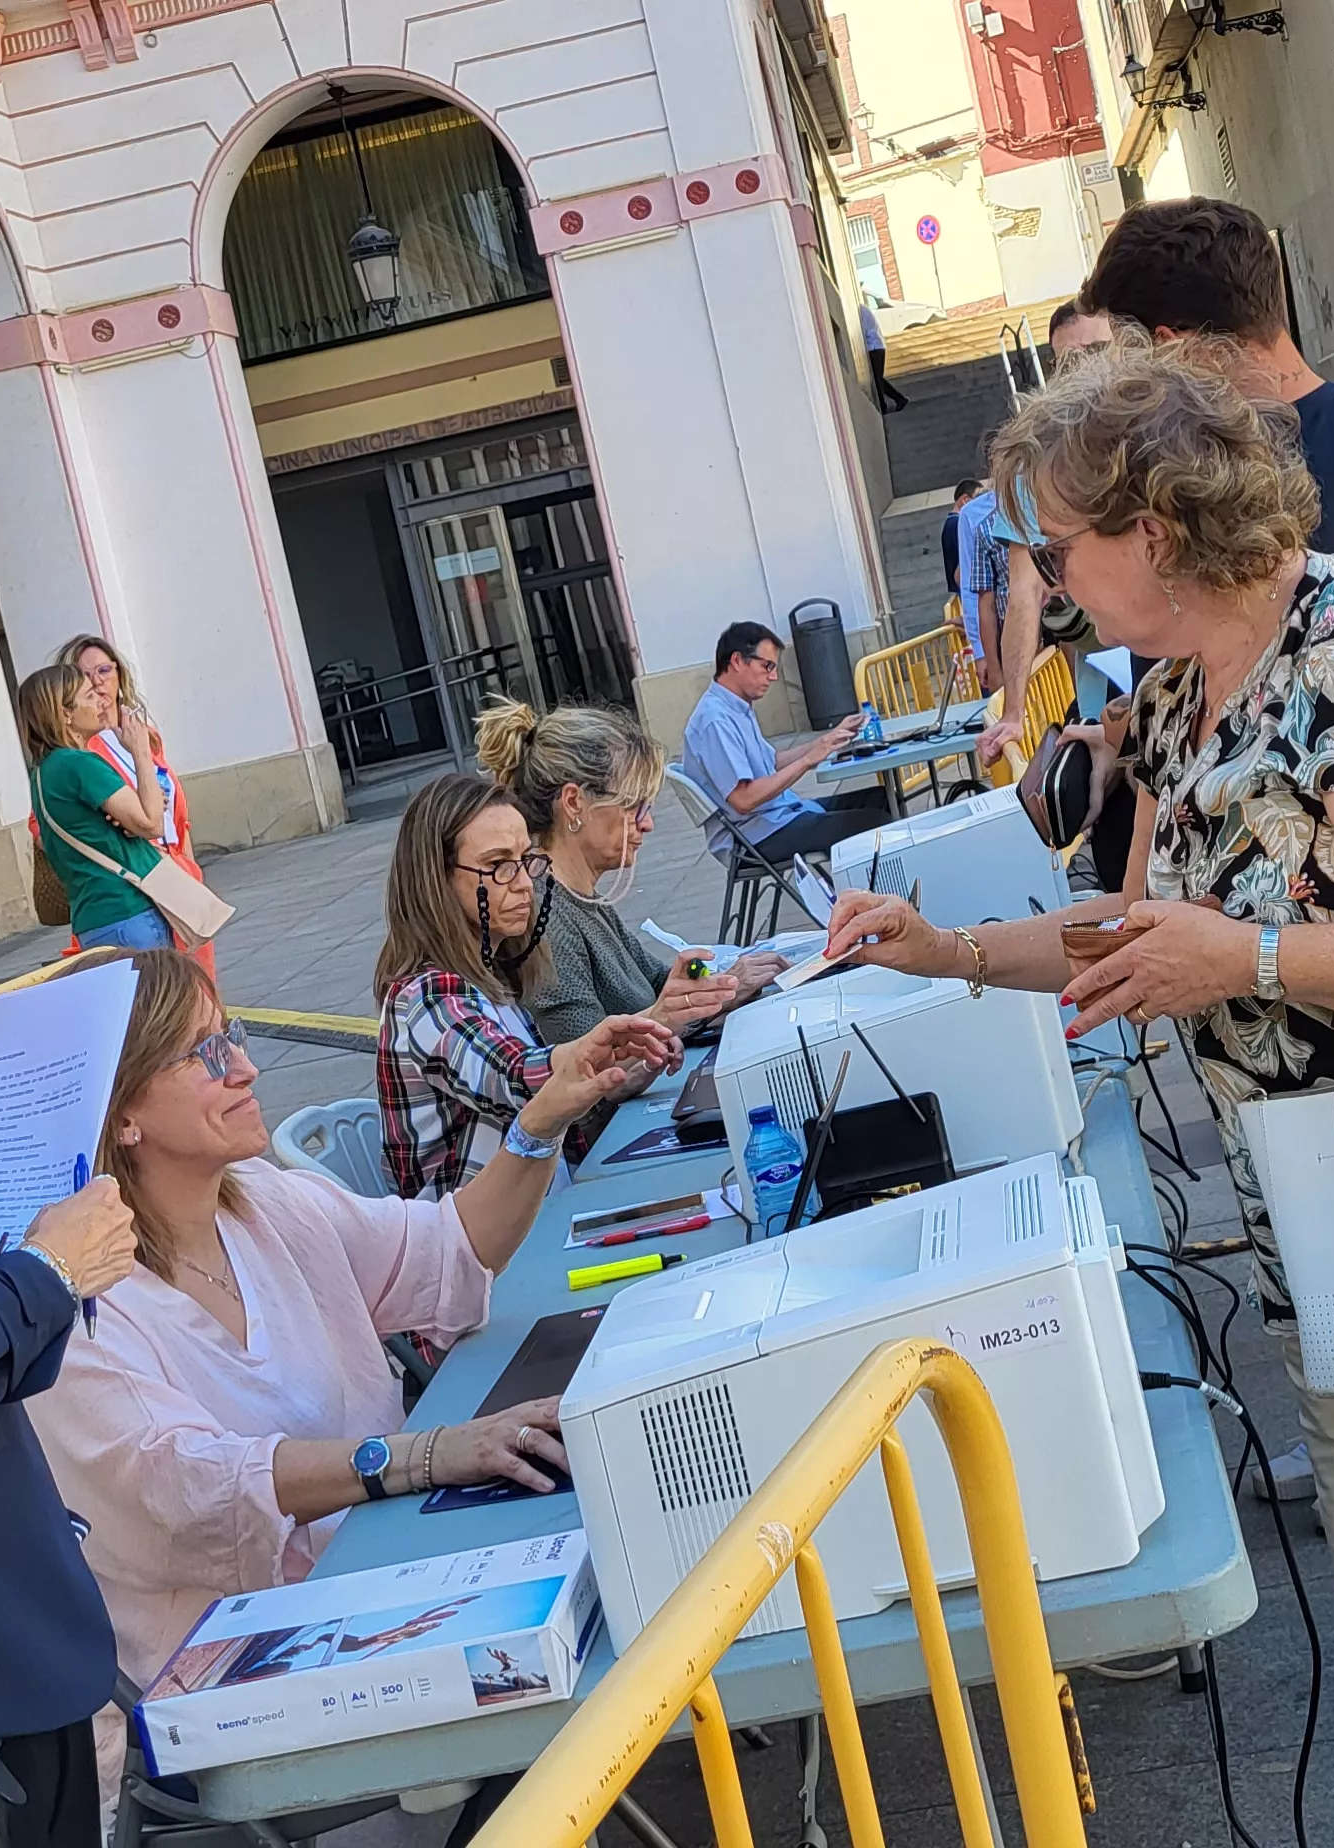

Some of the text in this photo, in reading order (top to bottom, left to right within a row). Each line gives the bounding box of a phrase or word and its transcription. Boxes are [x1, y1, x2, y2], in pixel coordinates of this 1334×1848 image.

[318, 421, 428, 464] MUNICIPAL
[979, 1318, 1061, 1351] IM23-013
[321, 1696, 336, 1708] 80
[351, 1690, 367, 1702] A4
[380, 1683, 403, 1696] 500
[251, 1708, 285, 1725] speed
